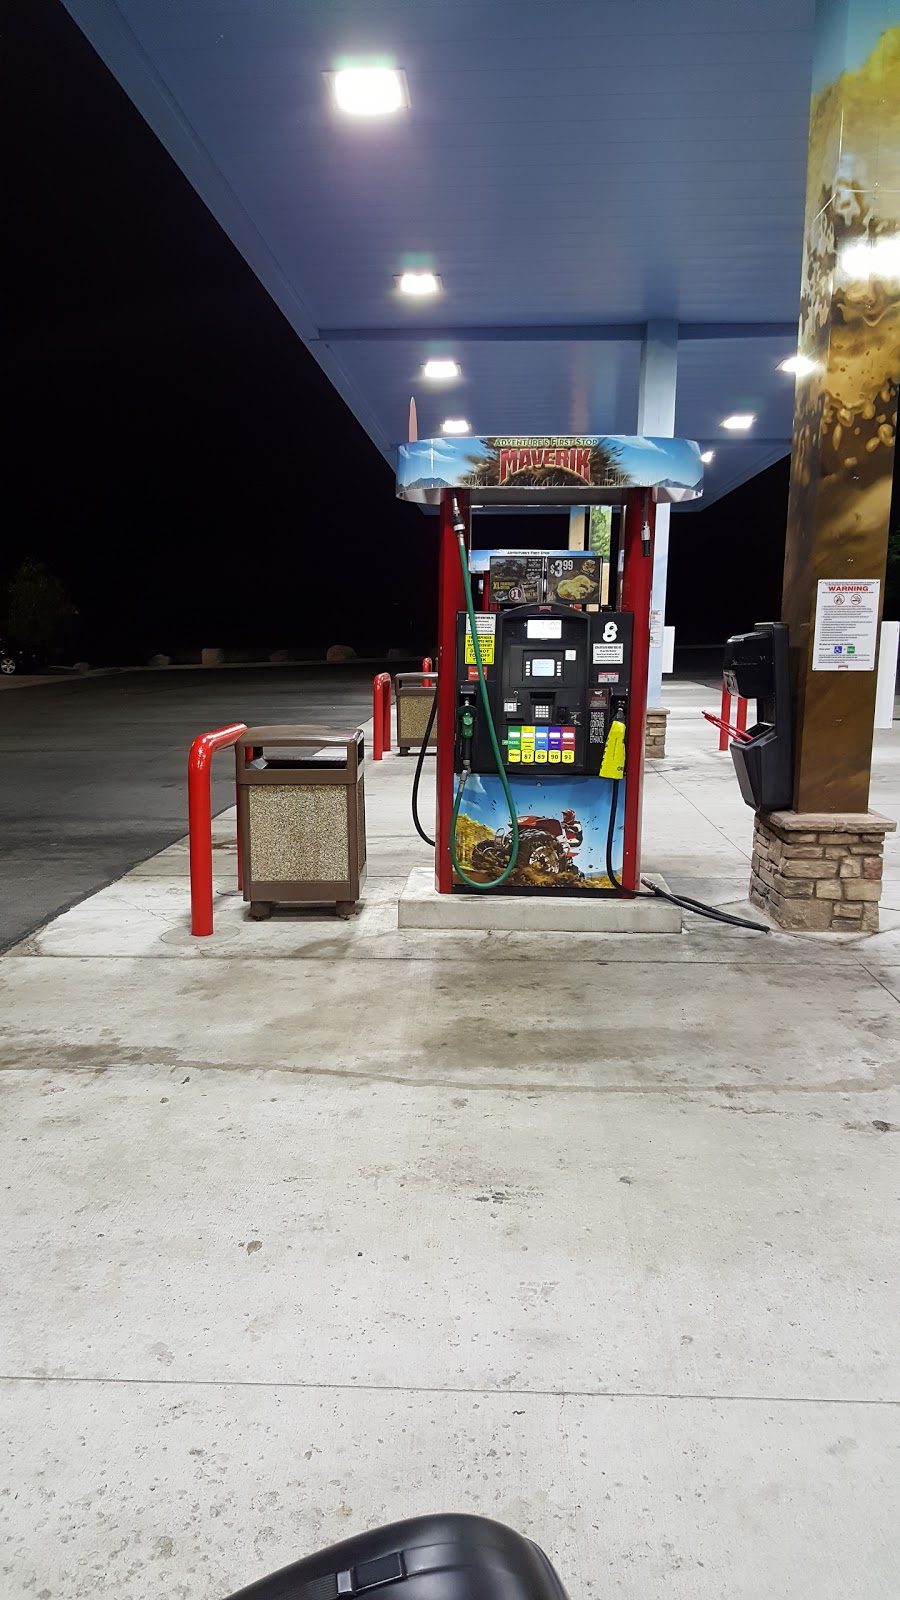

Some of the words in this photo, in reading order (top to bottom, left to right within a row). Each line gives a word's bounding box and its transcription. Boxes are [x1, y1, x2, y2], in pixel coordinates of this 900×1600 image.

[494, 437, 551, 447] ADVENTURE'S
[551, 437, 573, 446] FIRST
[576, 437, 598, 446] STOP
[500, 448, 590, 486] MAVERIK
[602, 621, 618, 642] 8
